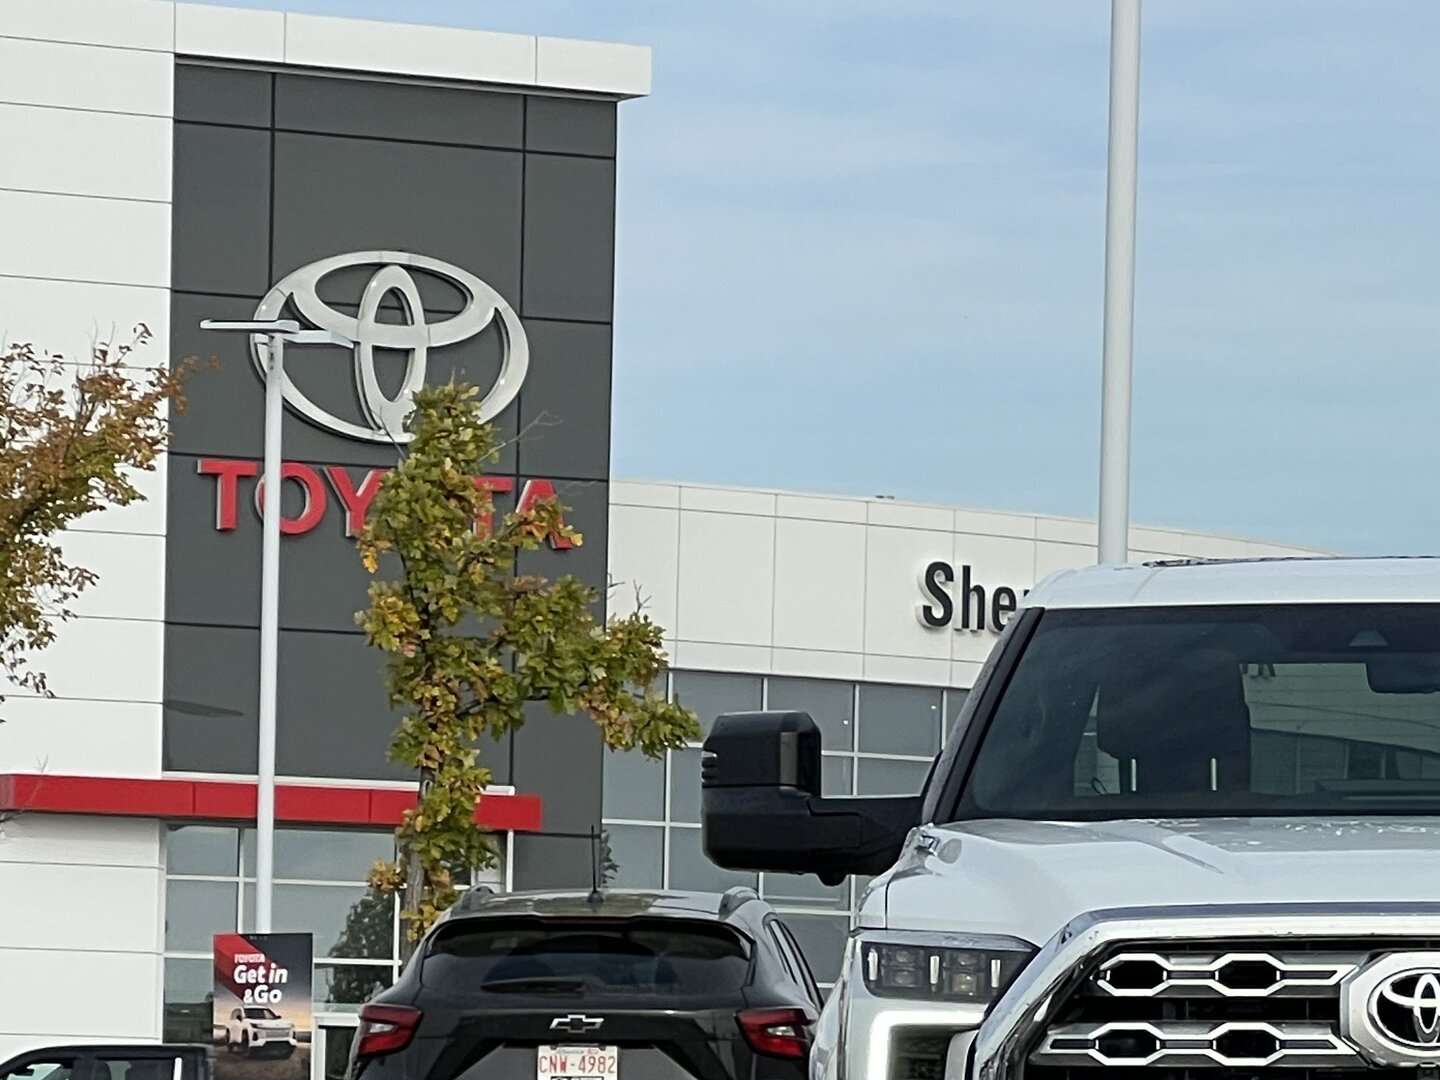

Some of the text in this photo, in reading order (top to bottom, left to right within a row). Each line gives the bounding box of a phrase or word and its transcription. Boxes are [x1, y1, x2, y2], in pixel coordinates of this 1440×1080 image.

[198, 459, 576, 552] TOYTA
[917, 560, 1031, 633] She
[233, 962, 288, 984] Get in
